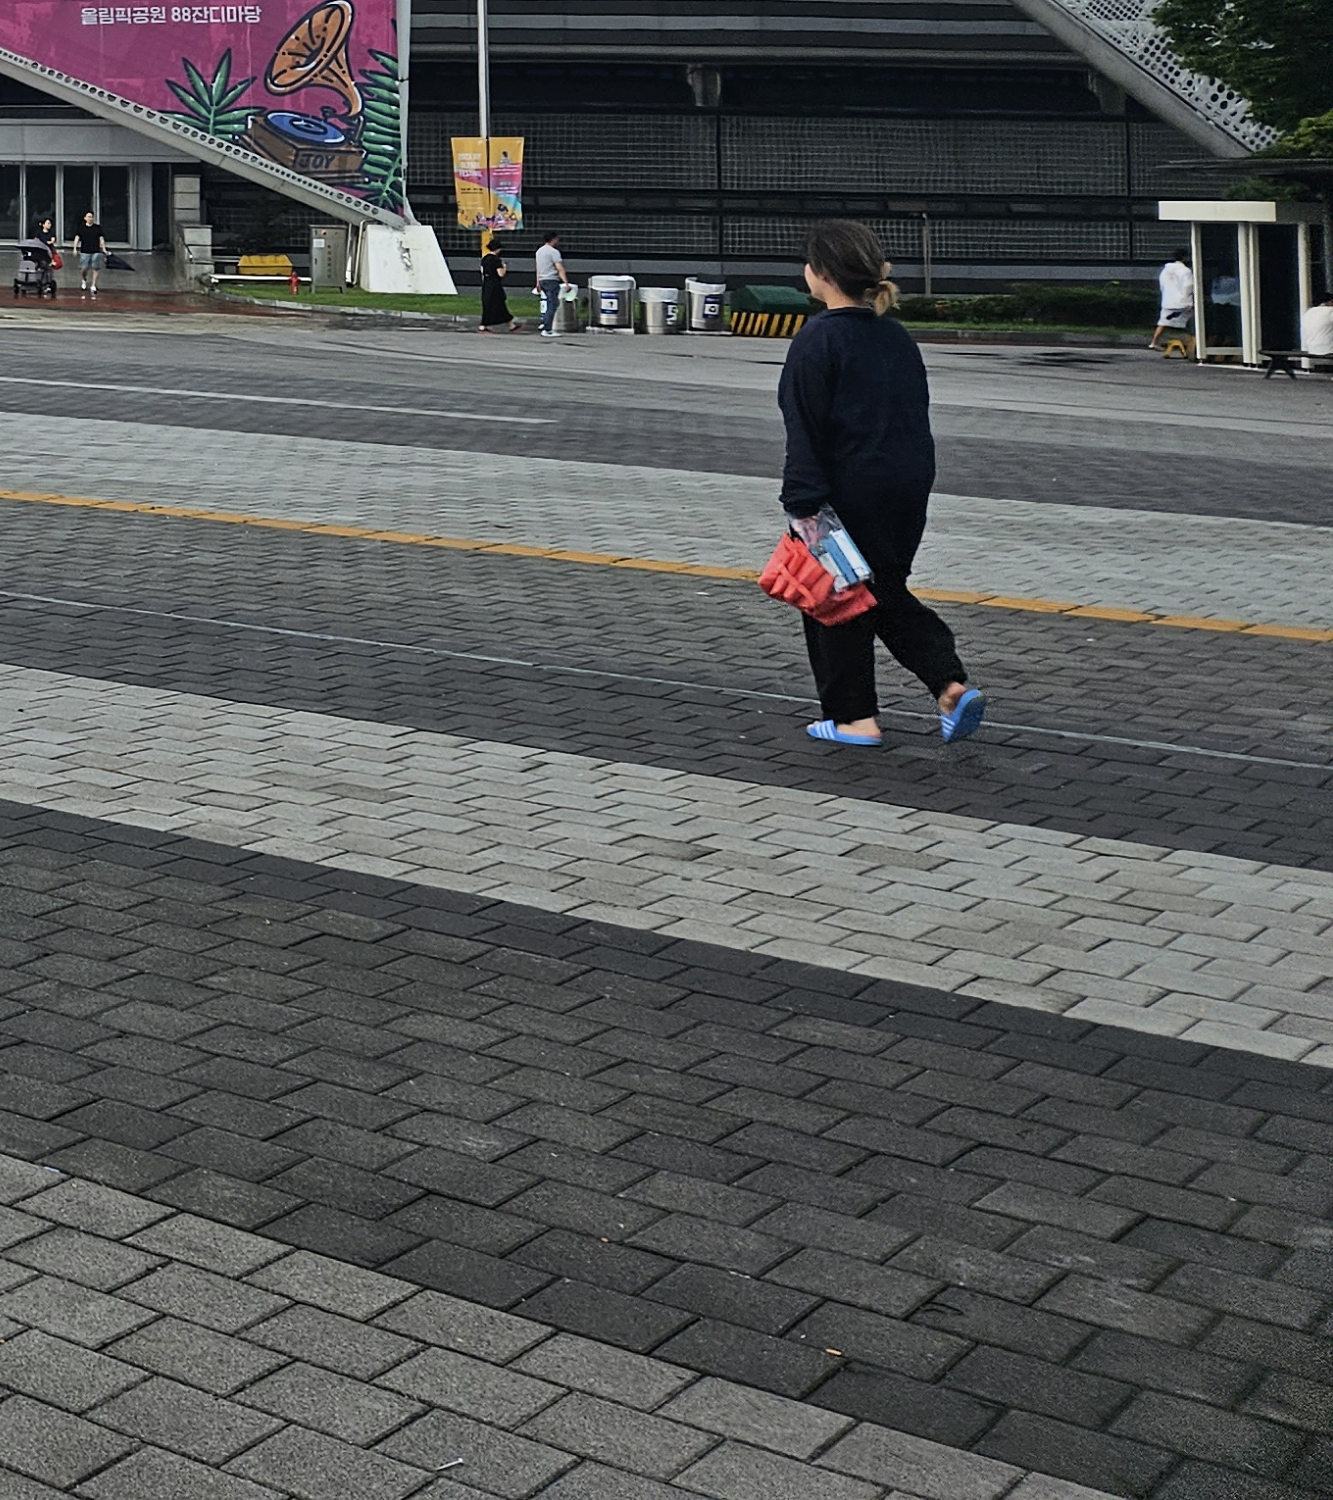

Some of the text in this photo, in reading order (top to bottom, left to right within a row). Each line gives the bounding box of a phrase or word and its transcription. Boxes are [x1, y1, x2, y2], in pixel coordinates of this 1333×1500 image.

[81, 6, 262, 25] 올림픽공원 88잔디마당
[298, 153, 335, 170] JOY
